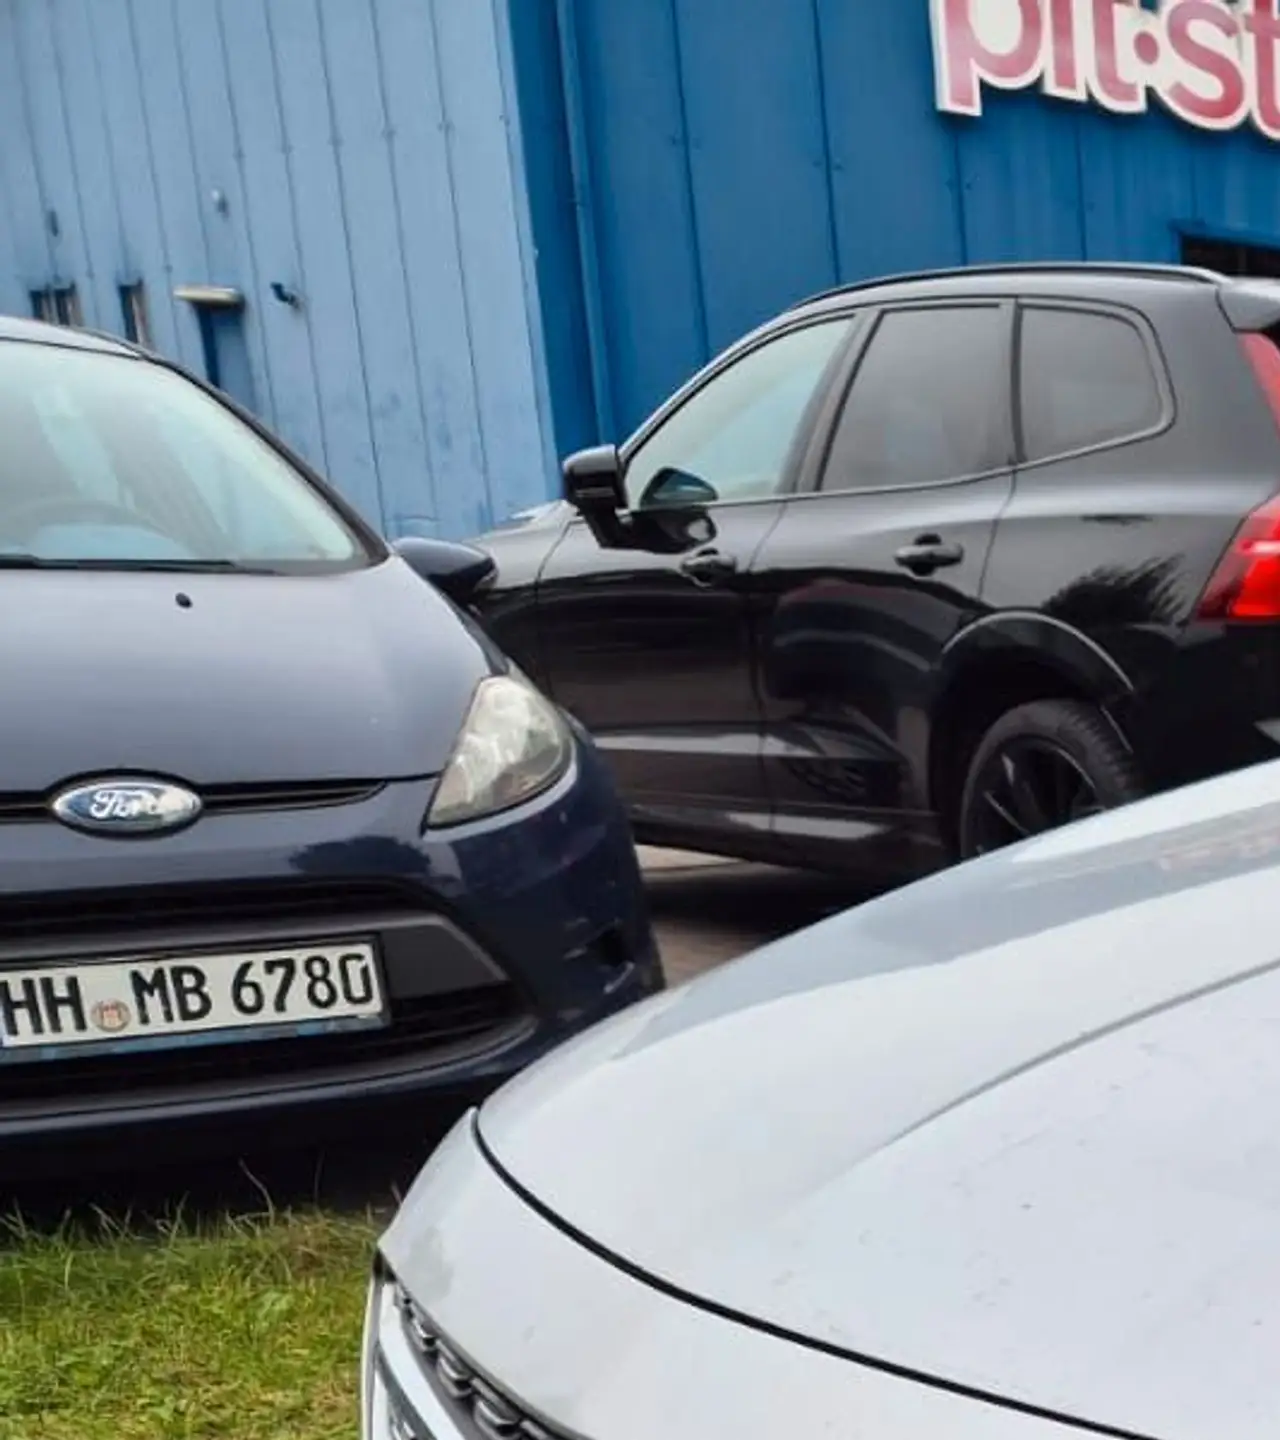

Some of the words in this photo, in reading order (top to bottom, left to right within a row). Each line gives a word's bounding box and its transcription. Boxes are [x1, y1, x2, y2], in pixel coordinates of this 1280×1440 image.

[91, 789, 163, 818] Ford
[0, 975, 87, 1036] HH
[131, 965, 212, 1025] MB
[231, 952, 374, 1015] 6780
